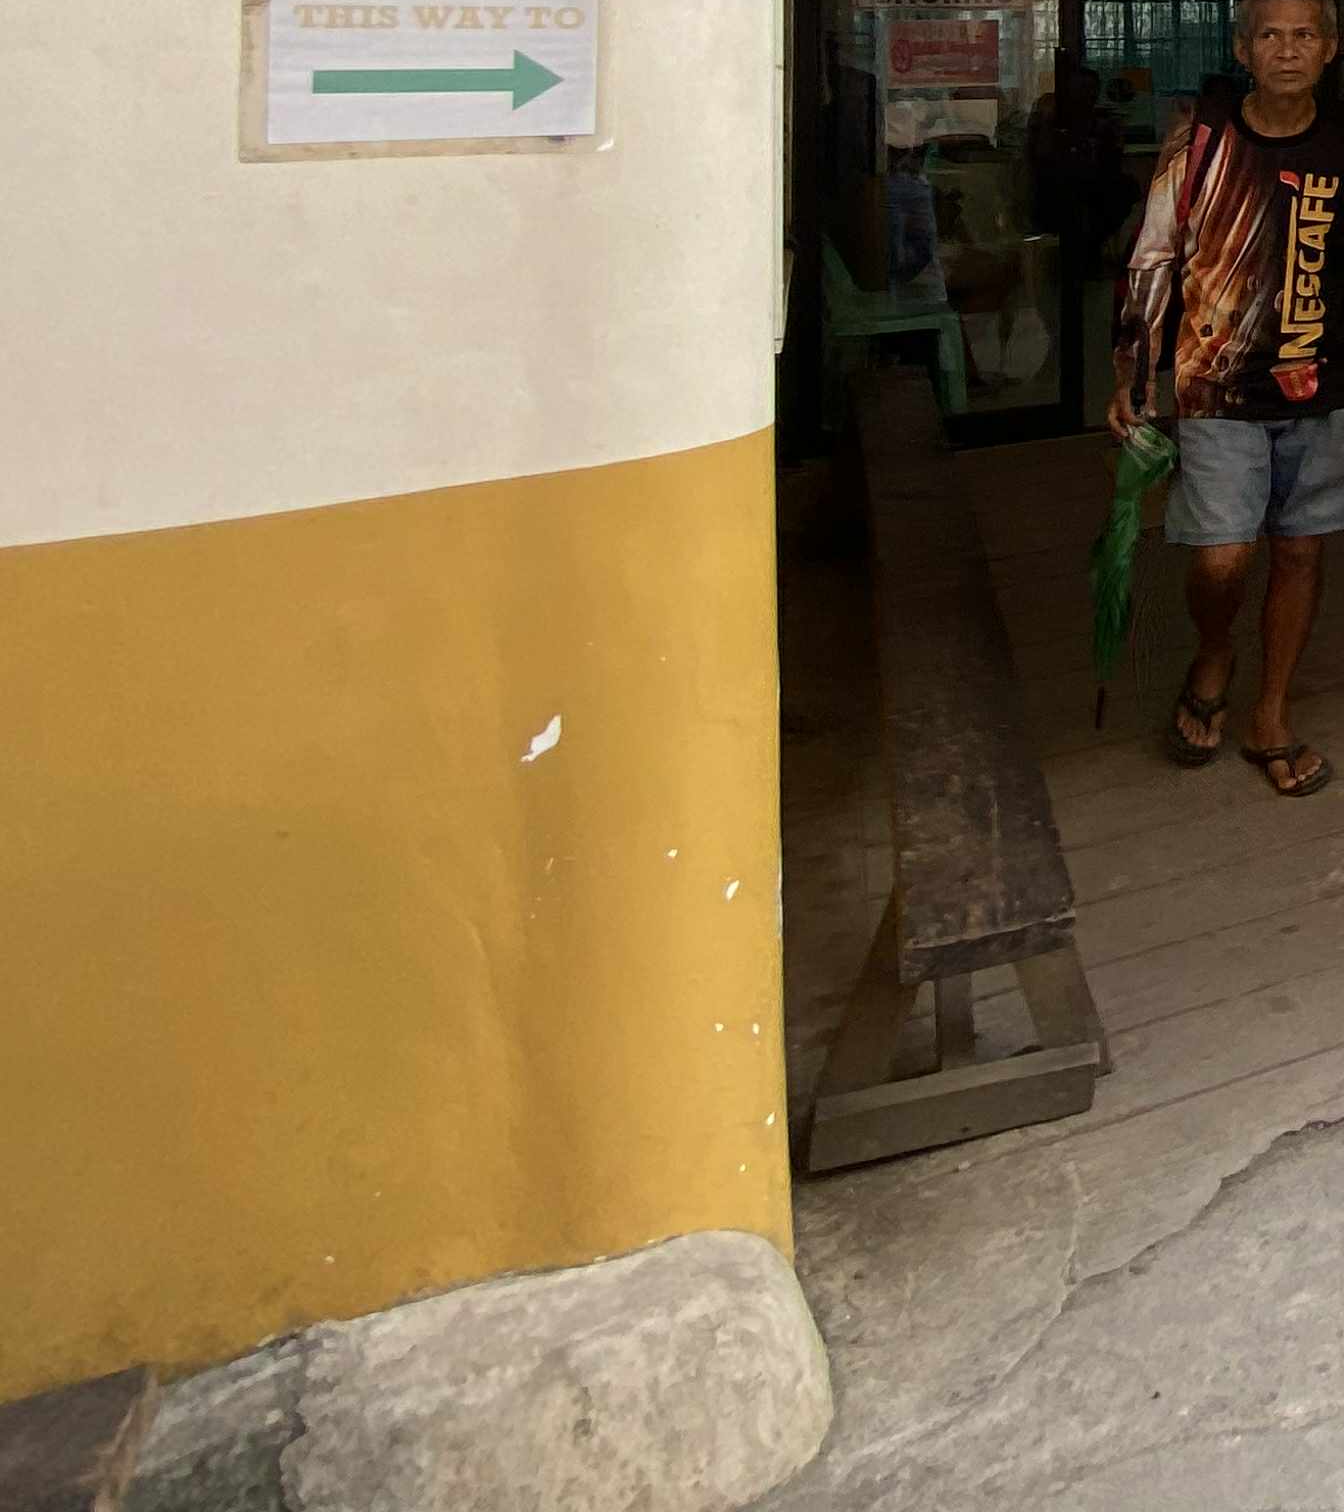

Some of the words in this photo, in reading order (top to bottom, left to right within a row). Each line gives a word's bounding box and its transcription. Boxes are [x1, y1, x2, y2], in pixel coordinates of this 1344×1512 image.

[294, 3, 398, 30] THIS
[412, 4, 516, 31] WAY
[524, 6, 587, 31] TO
